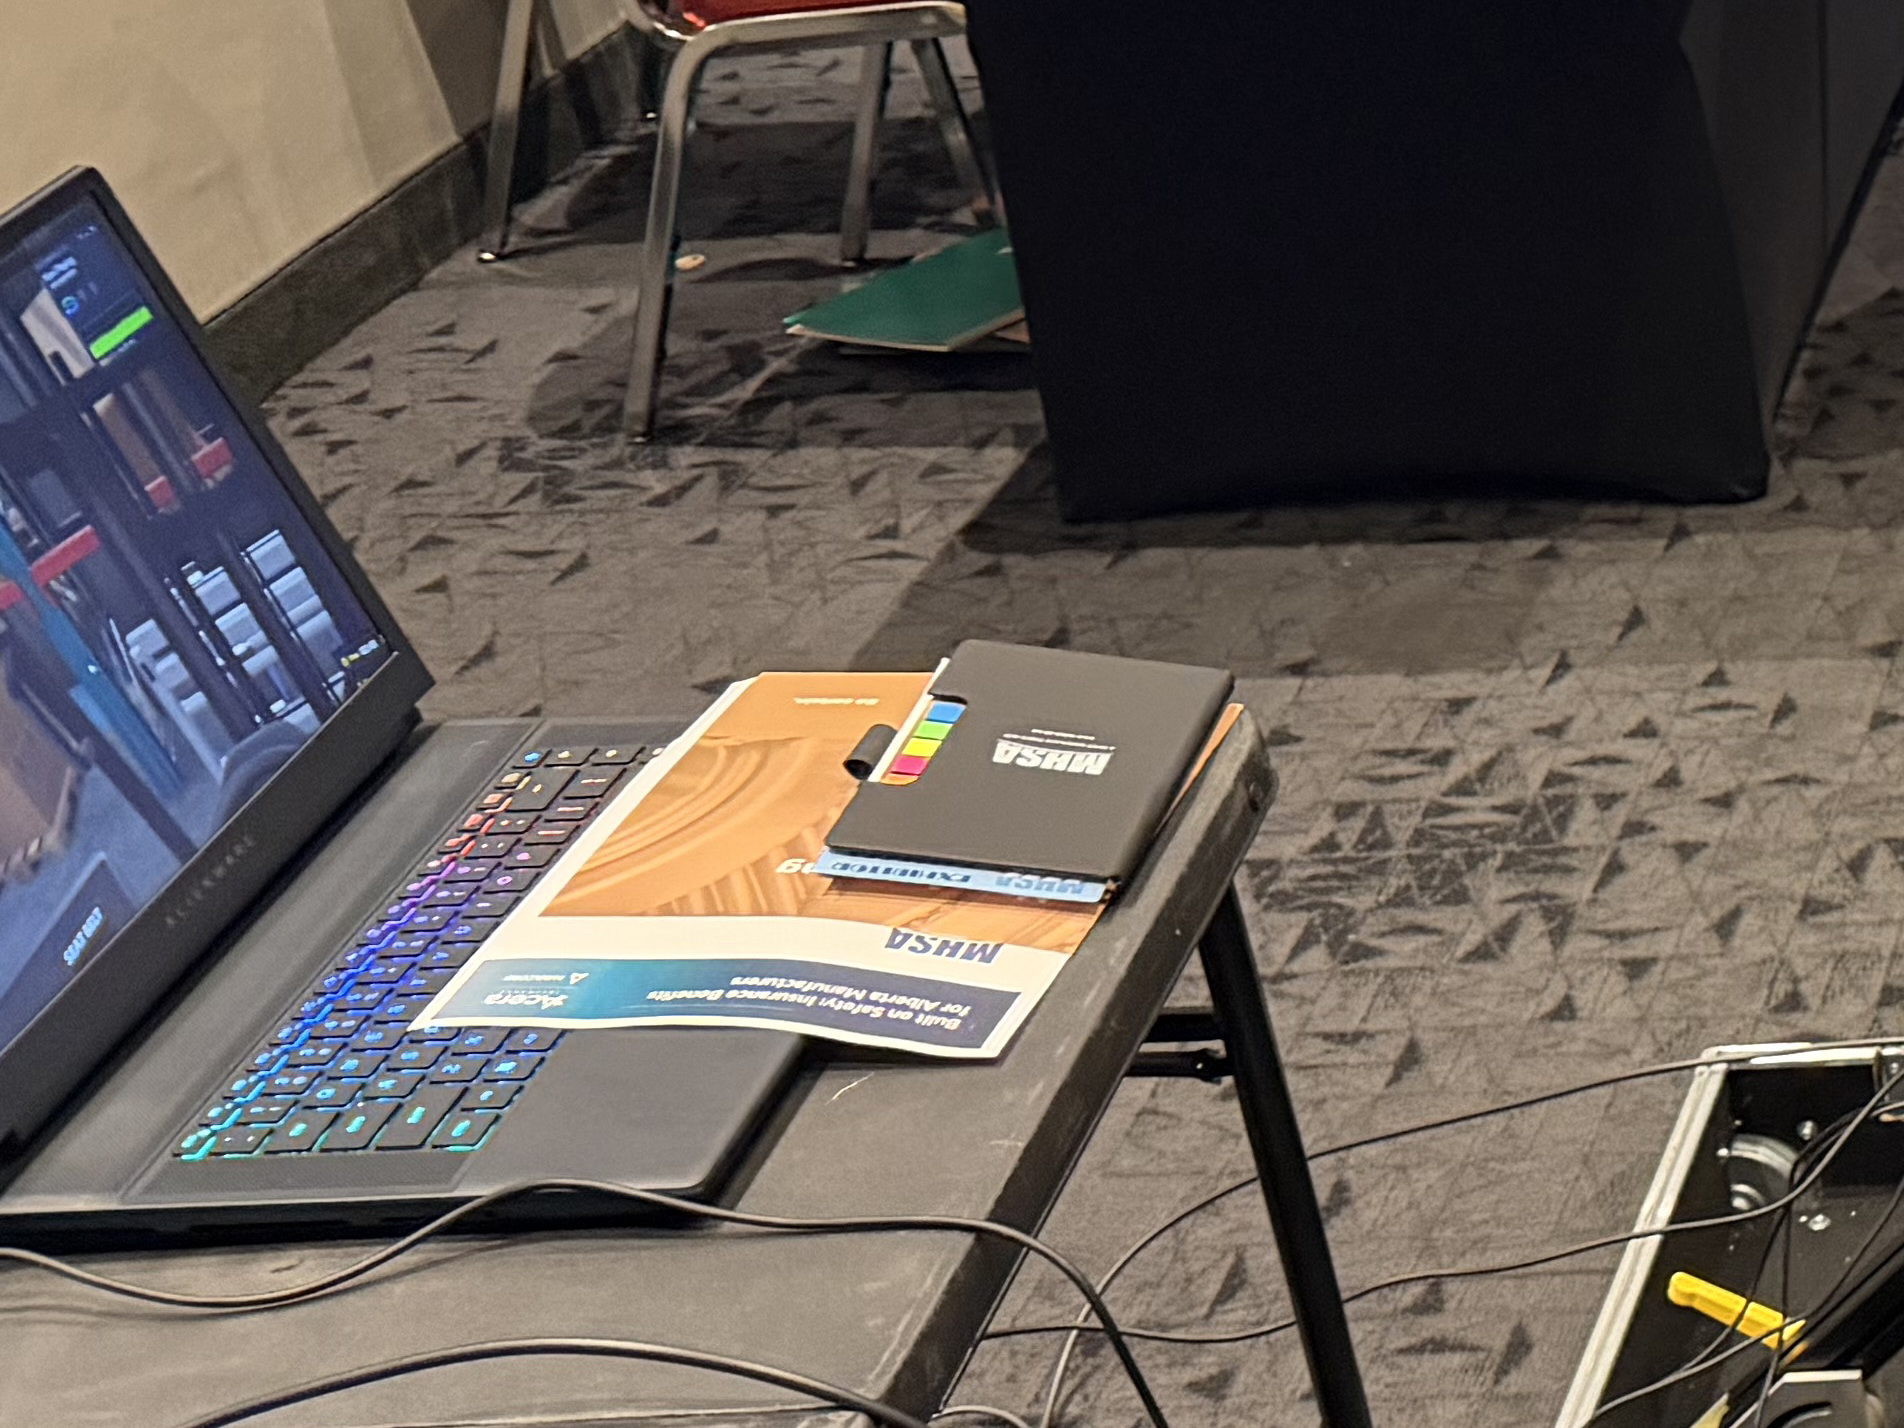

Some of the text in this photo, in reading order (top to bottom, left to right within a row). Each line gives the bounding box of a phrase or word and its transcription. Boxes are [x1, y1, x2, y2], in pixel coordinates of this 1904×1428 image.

[993, 738, 1114, 776] MHSA
[885, 927, 1006, 964] MHSA
[725, 988, 818, 1009] Insurance
[730, 976, 869, 1001] Manufacturers
[869, 991, 941, 1014] Alberta
[886, 1009, 914, 1021] on
[914, 1014, 962, 1032] Built
